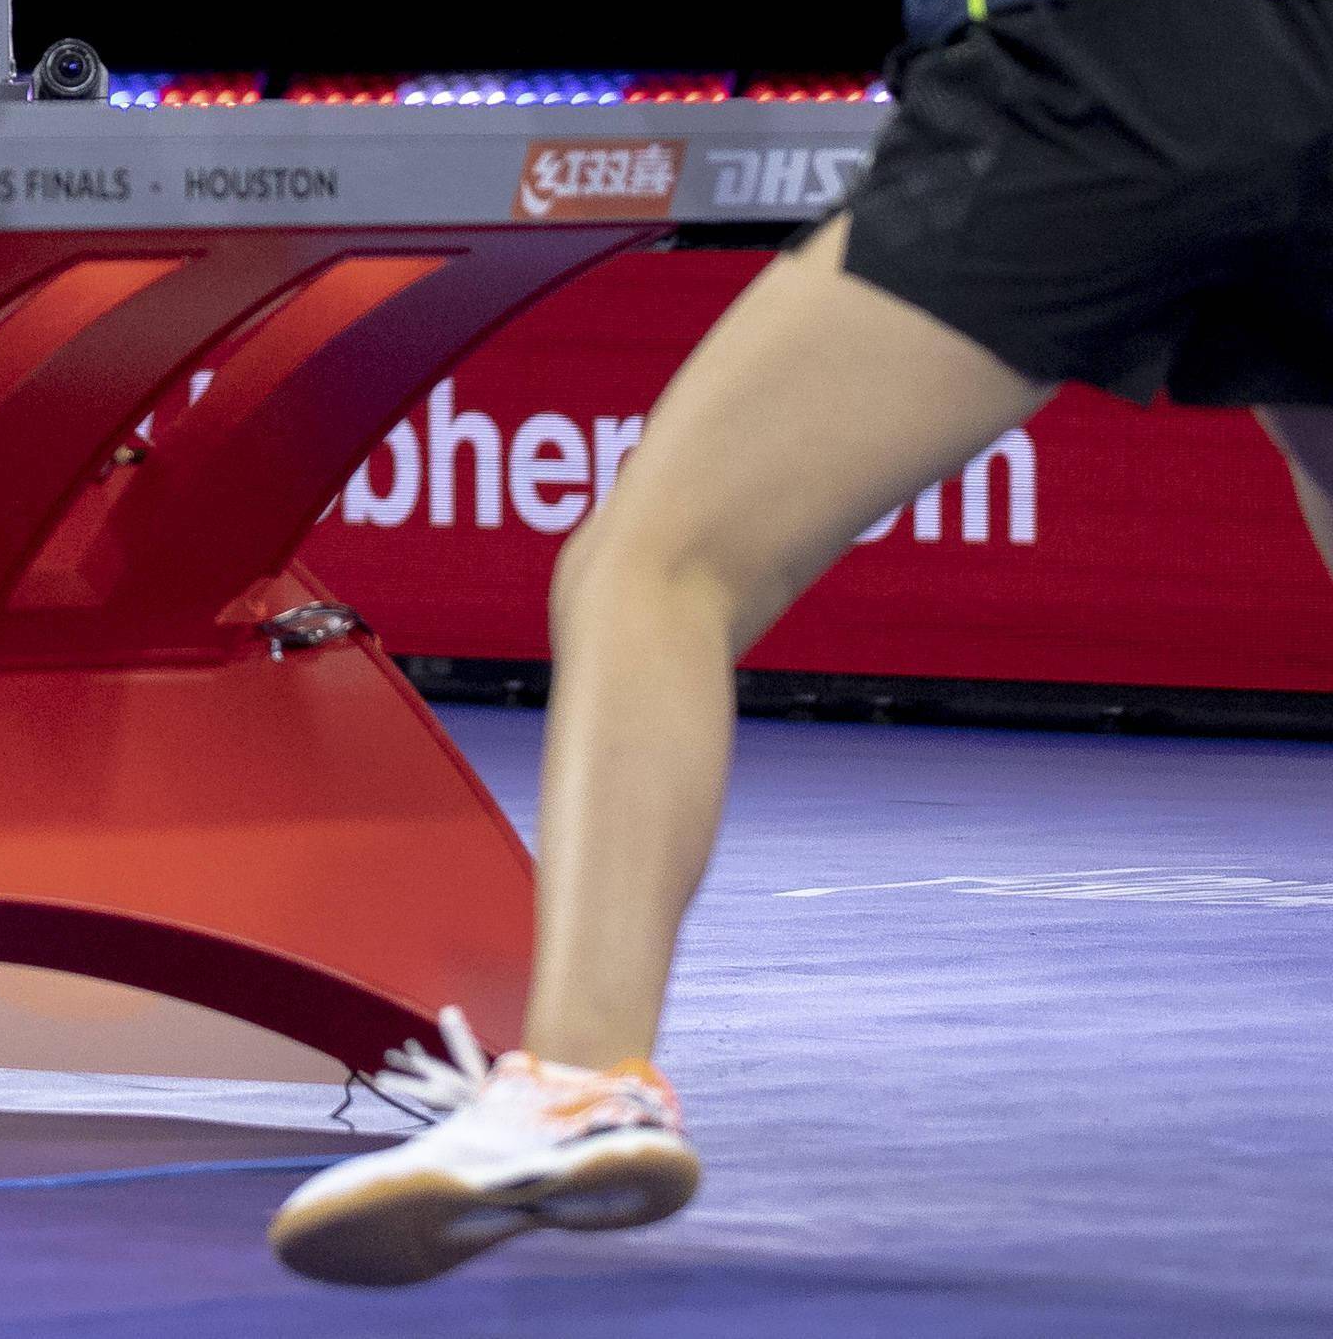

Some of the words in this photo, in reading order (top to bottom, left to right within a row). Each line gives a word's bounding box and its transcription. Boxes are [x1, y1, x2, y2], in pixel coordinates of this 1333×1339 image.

[26, 167, 131, 202] FINALS
[184, 166, 340, 202] HOUSTON
[705, 147, 874, 207] DHS
